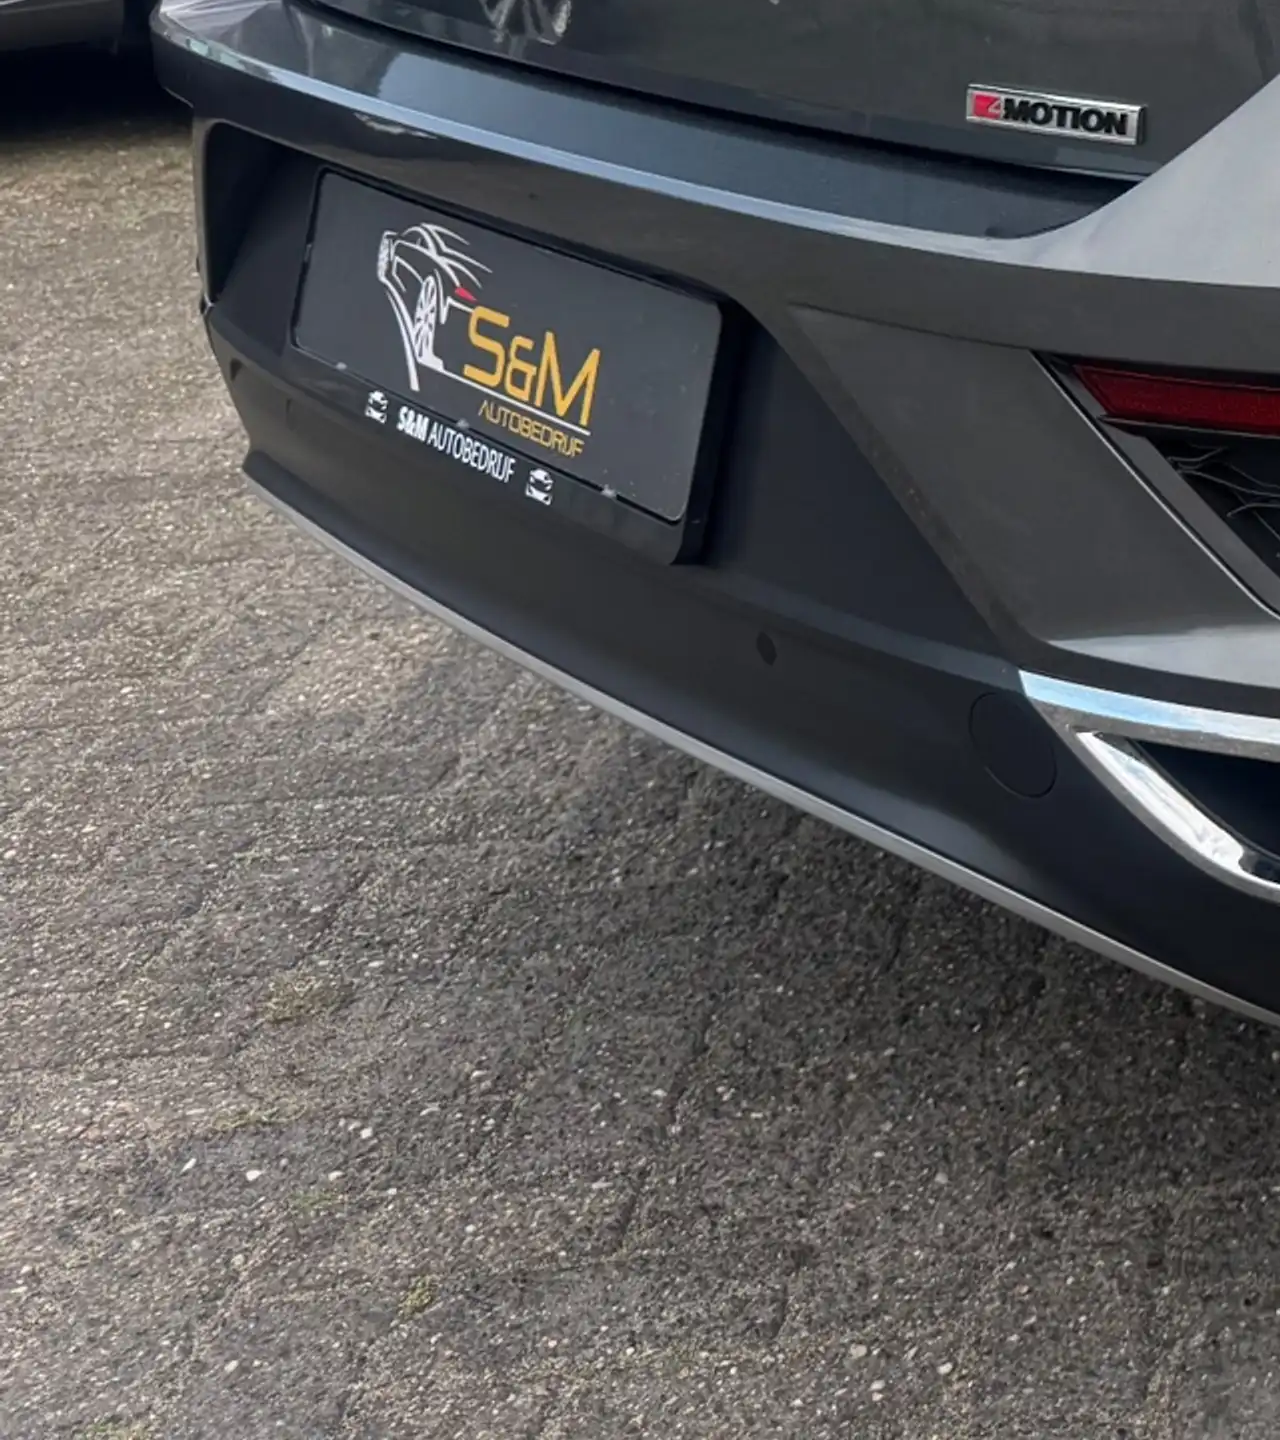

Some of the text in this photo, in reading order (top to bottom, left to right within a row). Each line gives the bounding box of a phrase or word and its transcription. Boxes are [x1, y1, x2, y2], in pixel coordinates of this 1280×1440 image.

[972, 92, 1128, 135] 4MOTION
[463, 306, 600, 426] S&M
[396, 406, 516, 483] S&M AUTOBEDRIJF
[478, 399, 585, 458] AUTOBEDRIJF
